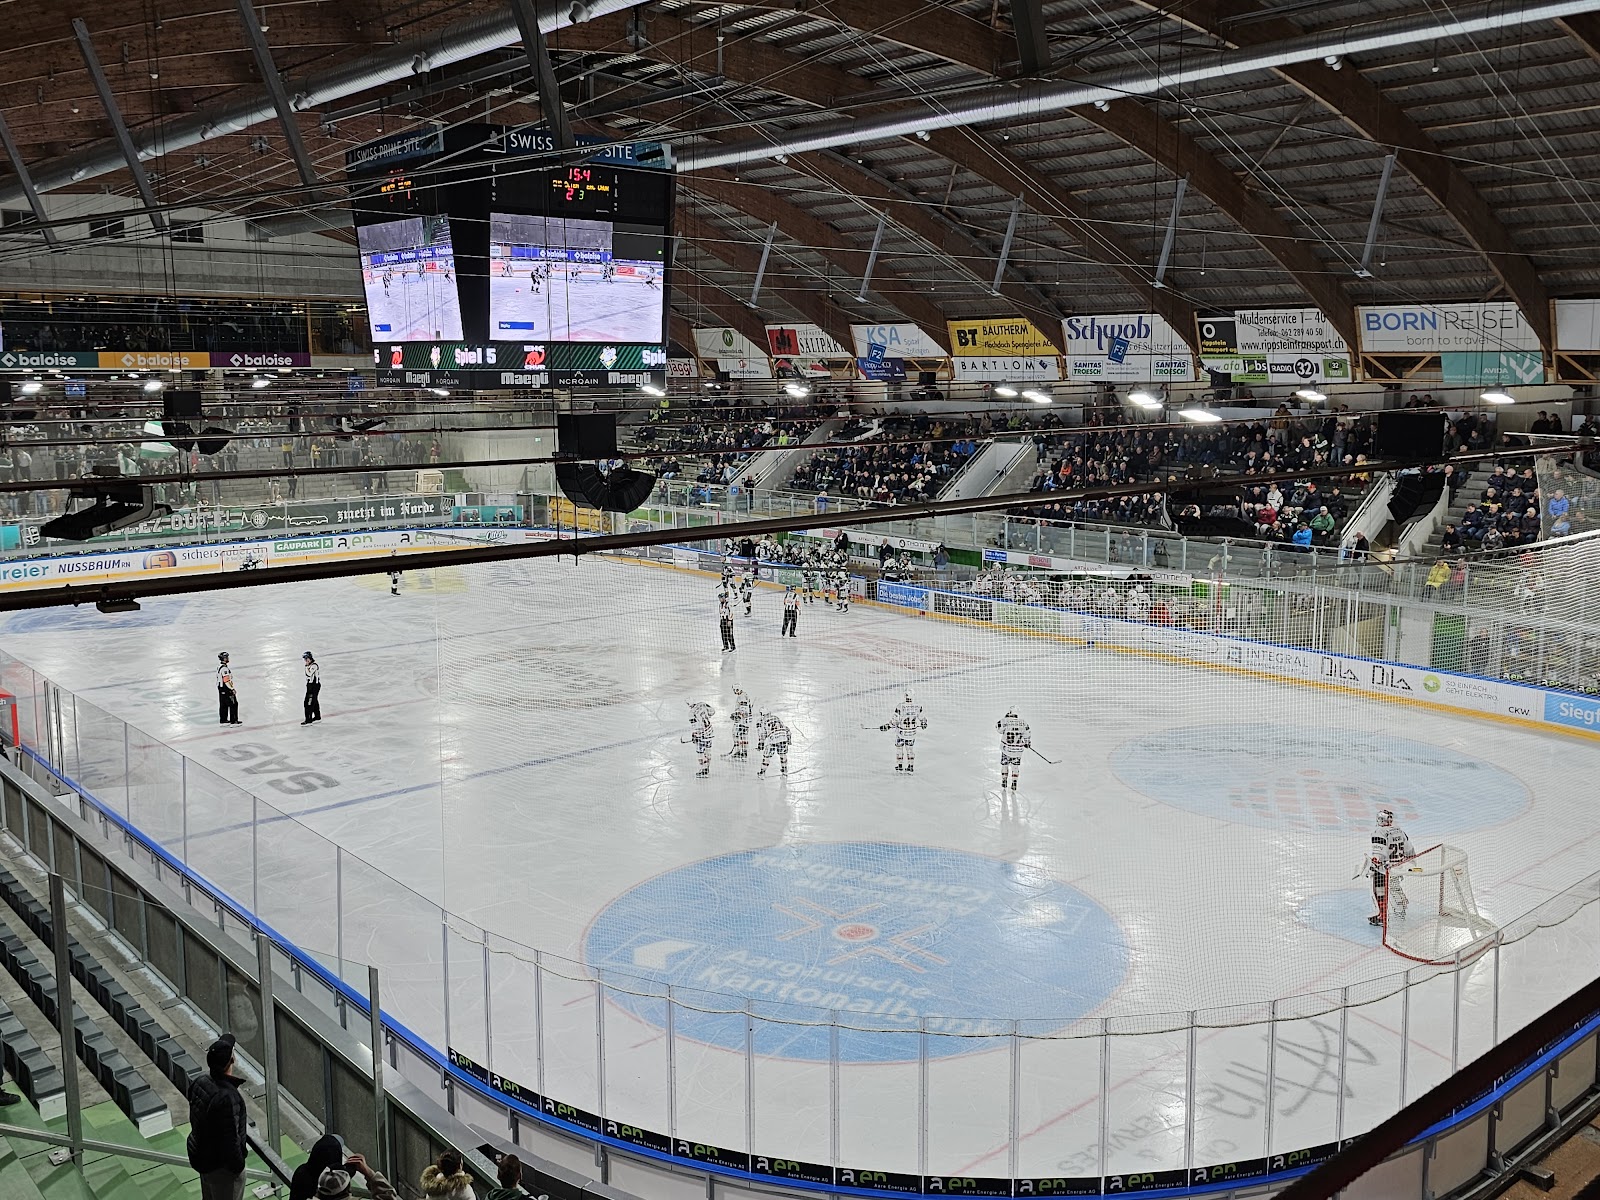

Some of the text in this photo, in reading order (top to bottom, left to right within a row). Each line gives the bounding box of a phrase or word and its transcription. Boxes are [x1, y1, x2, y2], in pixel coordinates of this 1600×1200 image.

[356, 145, 378, 162] SWISS
[379, 139, 402, 160] PRIME
[510, 133, 554, 151] SWISS
[605, 145, 633, 160] SITE
[1240, 312, 1297, 325] Muldenservice
[1366, 311, 1437, 331] BORN
[866, 326, 901, 346] KSA
[982, 324, 1029, 336] BAUTHERM
[1067, 316, 1151, 351] Schwob
[1306, 328, 1314, 336] 40
[1315, 328, 1323, 336] 50
[956, 328, 978, 347] BT
[1406, 334, 1489, 346] born to travel
[1113, 345, 1124, 356] F3
[1240, 337, 1344, 353] www.rippsteintransport.ch
[18, 353, 77, 366] baloise
[136, 353, 190, 366] baloise
[244, 353, 293, 366] baloise
[454, 347, 497, 367] Spiel 5
[871, 349, 881, 359] F2
[1270, 361, 1312, 376] RADIO 32
[501, 372, 549, 388] Maegli
[380, 505, 395, 517] im
[400, 501, 435, 515] Norde
[0, 563, 49, 580] reier
[58, 559, 121, 573] NUSSBAUM
[1246, 648, 1310, 668] INTEGRAL
[1445, 687, 1464, 695] GEHT
[1457, 682, 1487, 692] EINFACH
[1389, 842, 1405, 860] 25
[718, 1160, 736, 1168] Energie
[800, 1174, 820, 1182] Energie
